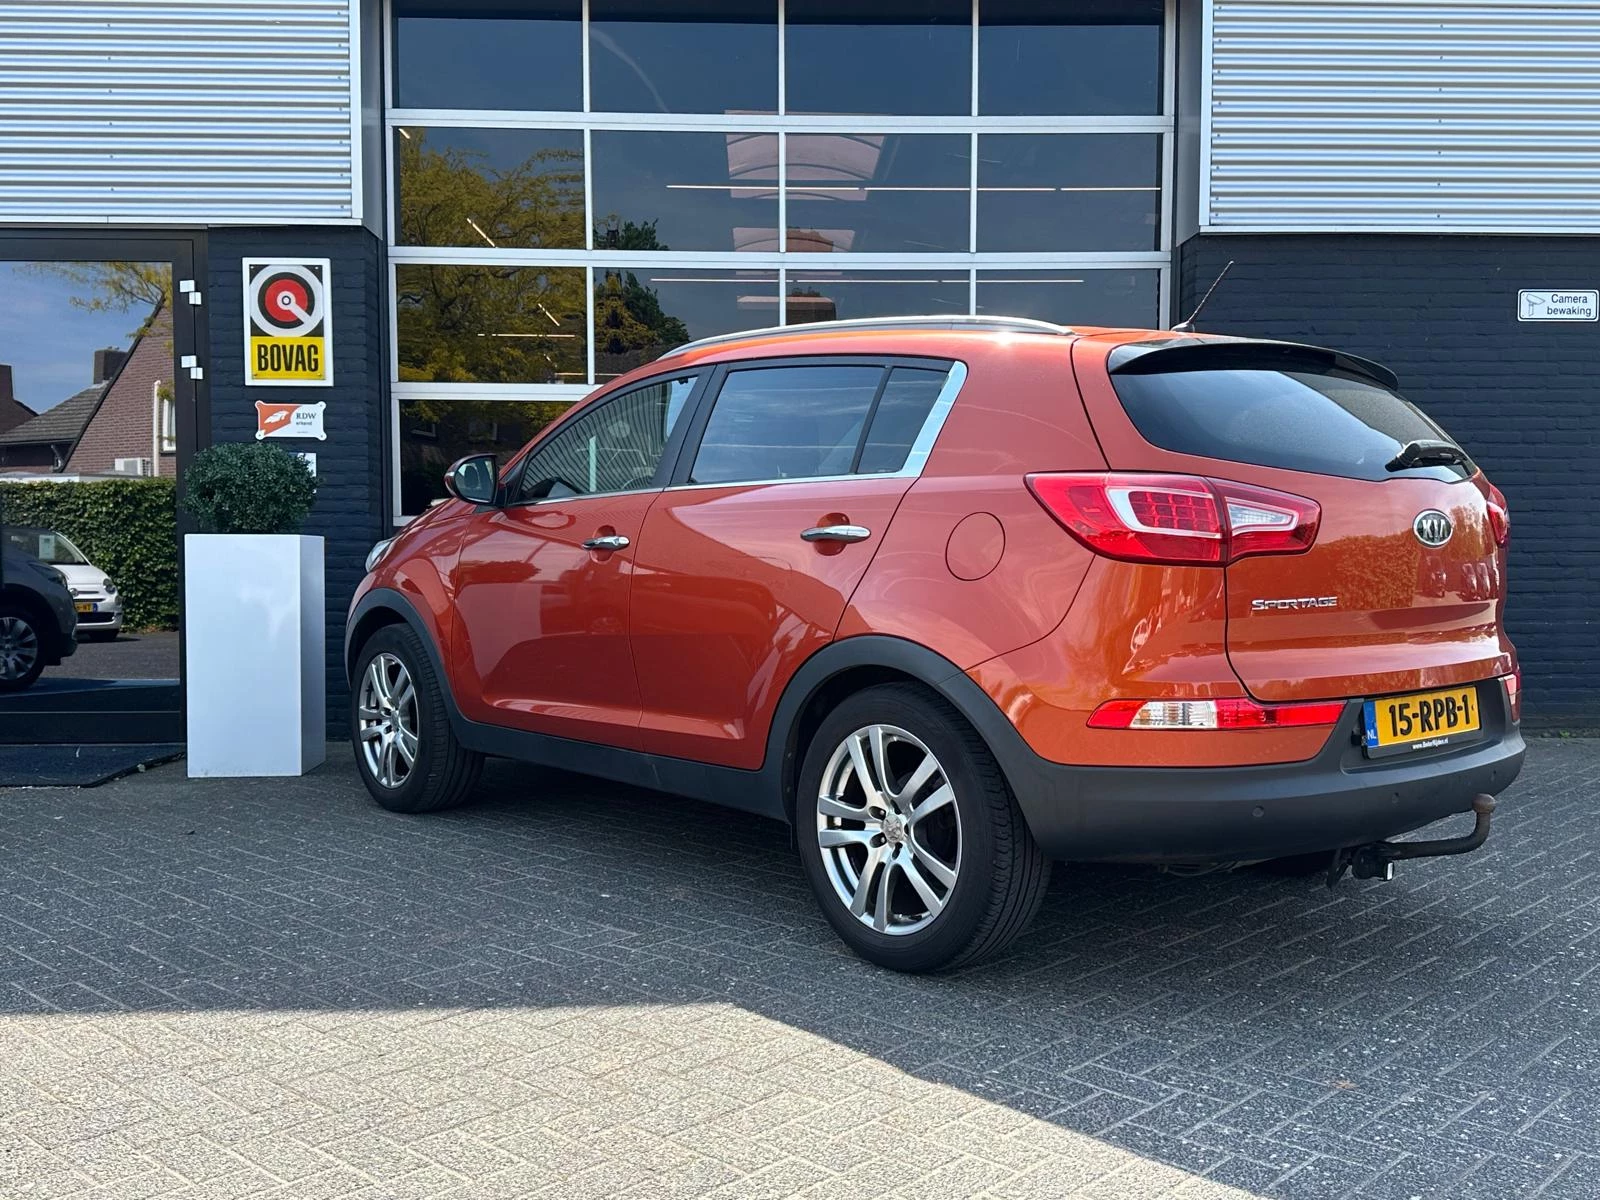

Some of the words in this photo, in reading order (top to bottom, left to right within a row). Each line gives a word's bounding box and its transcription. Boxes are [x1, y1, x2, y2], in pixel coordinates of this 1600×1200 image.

[1551, 294, 1588, 304] Camera
[1547, 306, 1592, 317] bewaking
[257, 343, 319, 372] BOVAG
[296, 412, 317, 420] RDW
[1422, 519, 1448, 539] KIA
[1251, 596, 1338, 611] SPORTAGE
[1389, 694, 1470, 737] 15-RPB-1
[1366, 729, 1377, 740] NL
